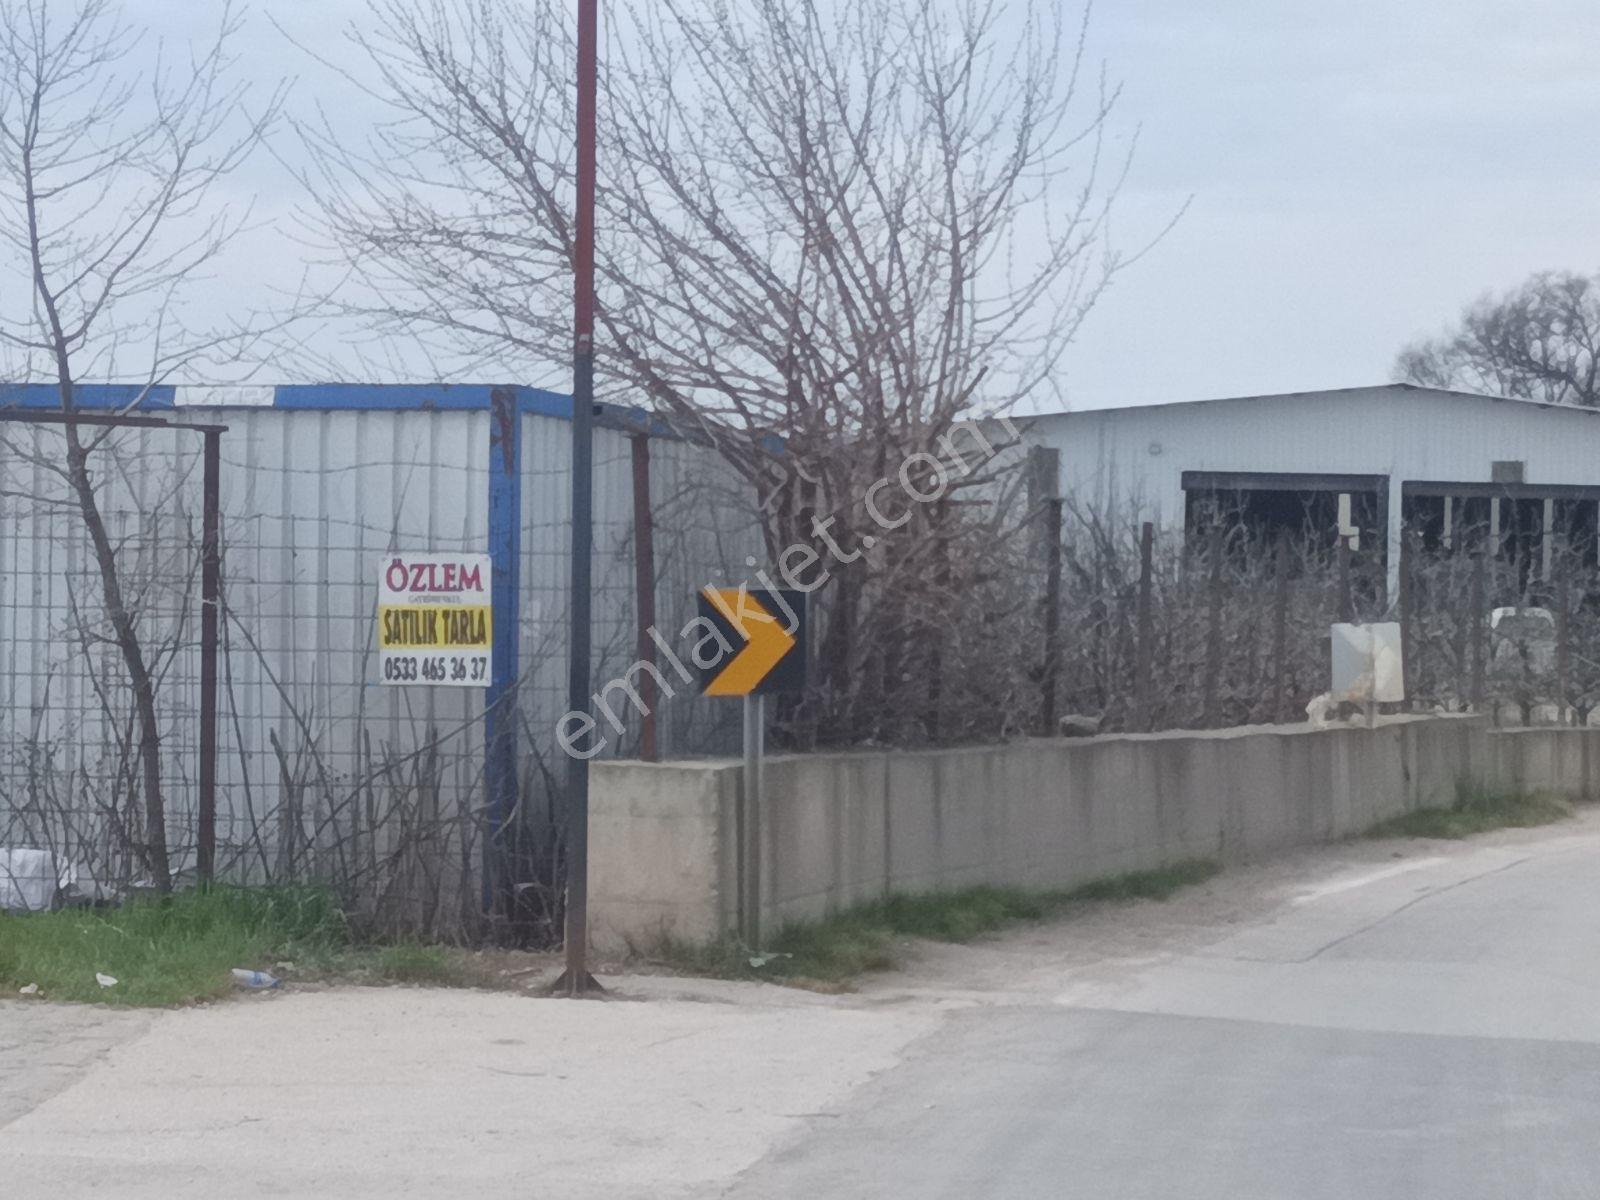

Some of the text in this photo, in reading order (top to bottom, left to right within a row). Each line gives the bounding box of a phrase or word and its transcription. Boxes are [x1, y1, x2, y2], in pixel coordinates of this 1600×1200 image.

[386, 558, 484, 592] ÖZLEM
[384, 609, 487, 645] SATILIK TARLA
[385, 657, 487, 681] 0533 465 36 37
